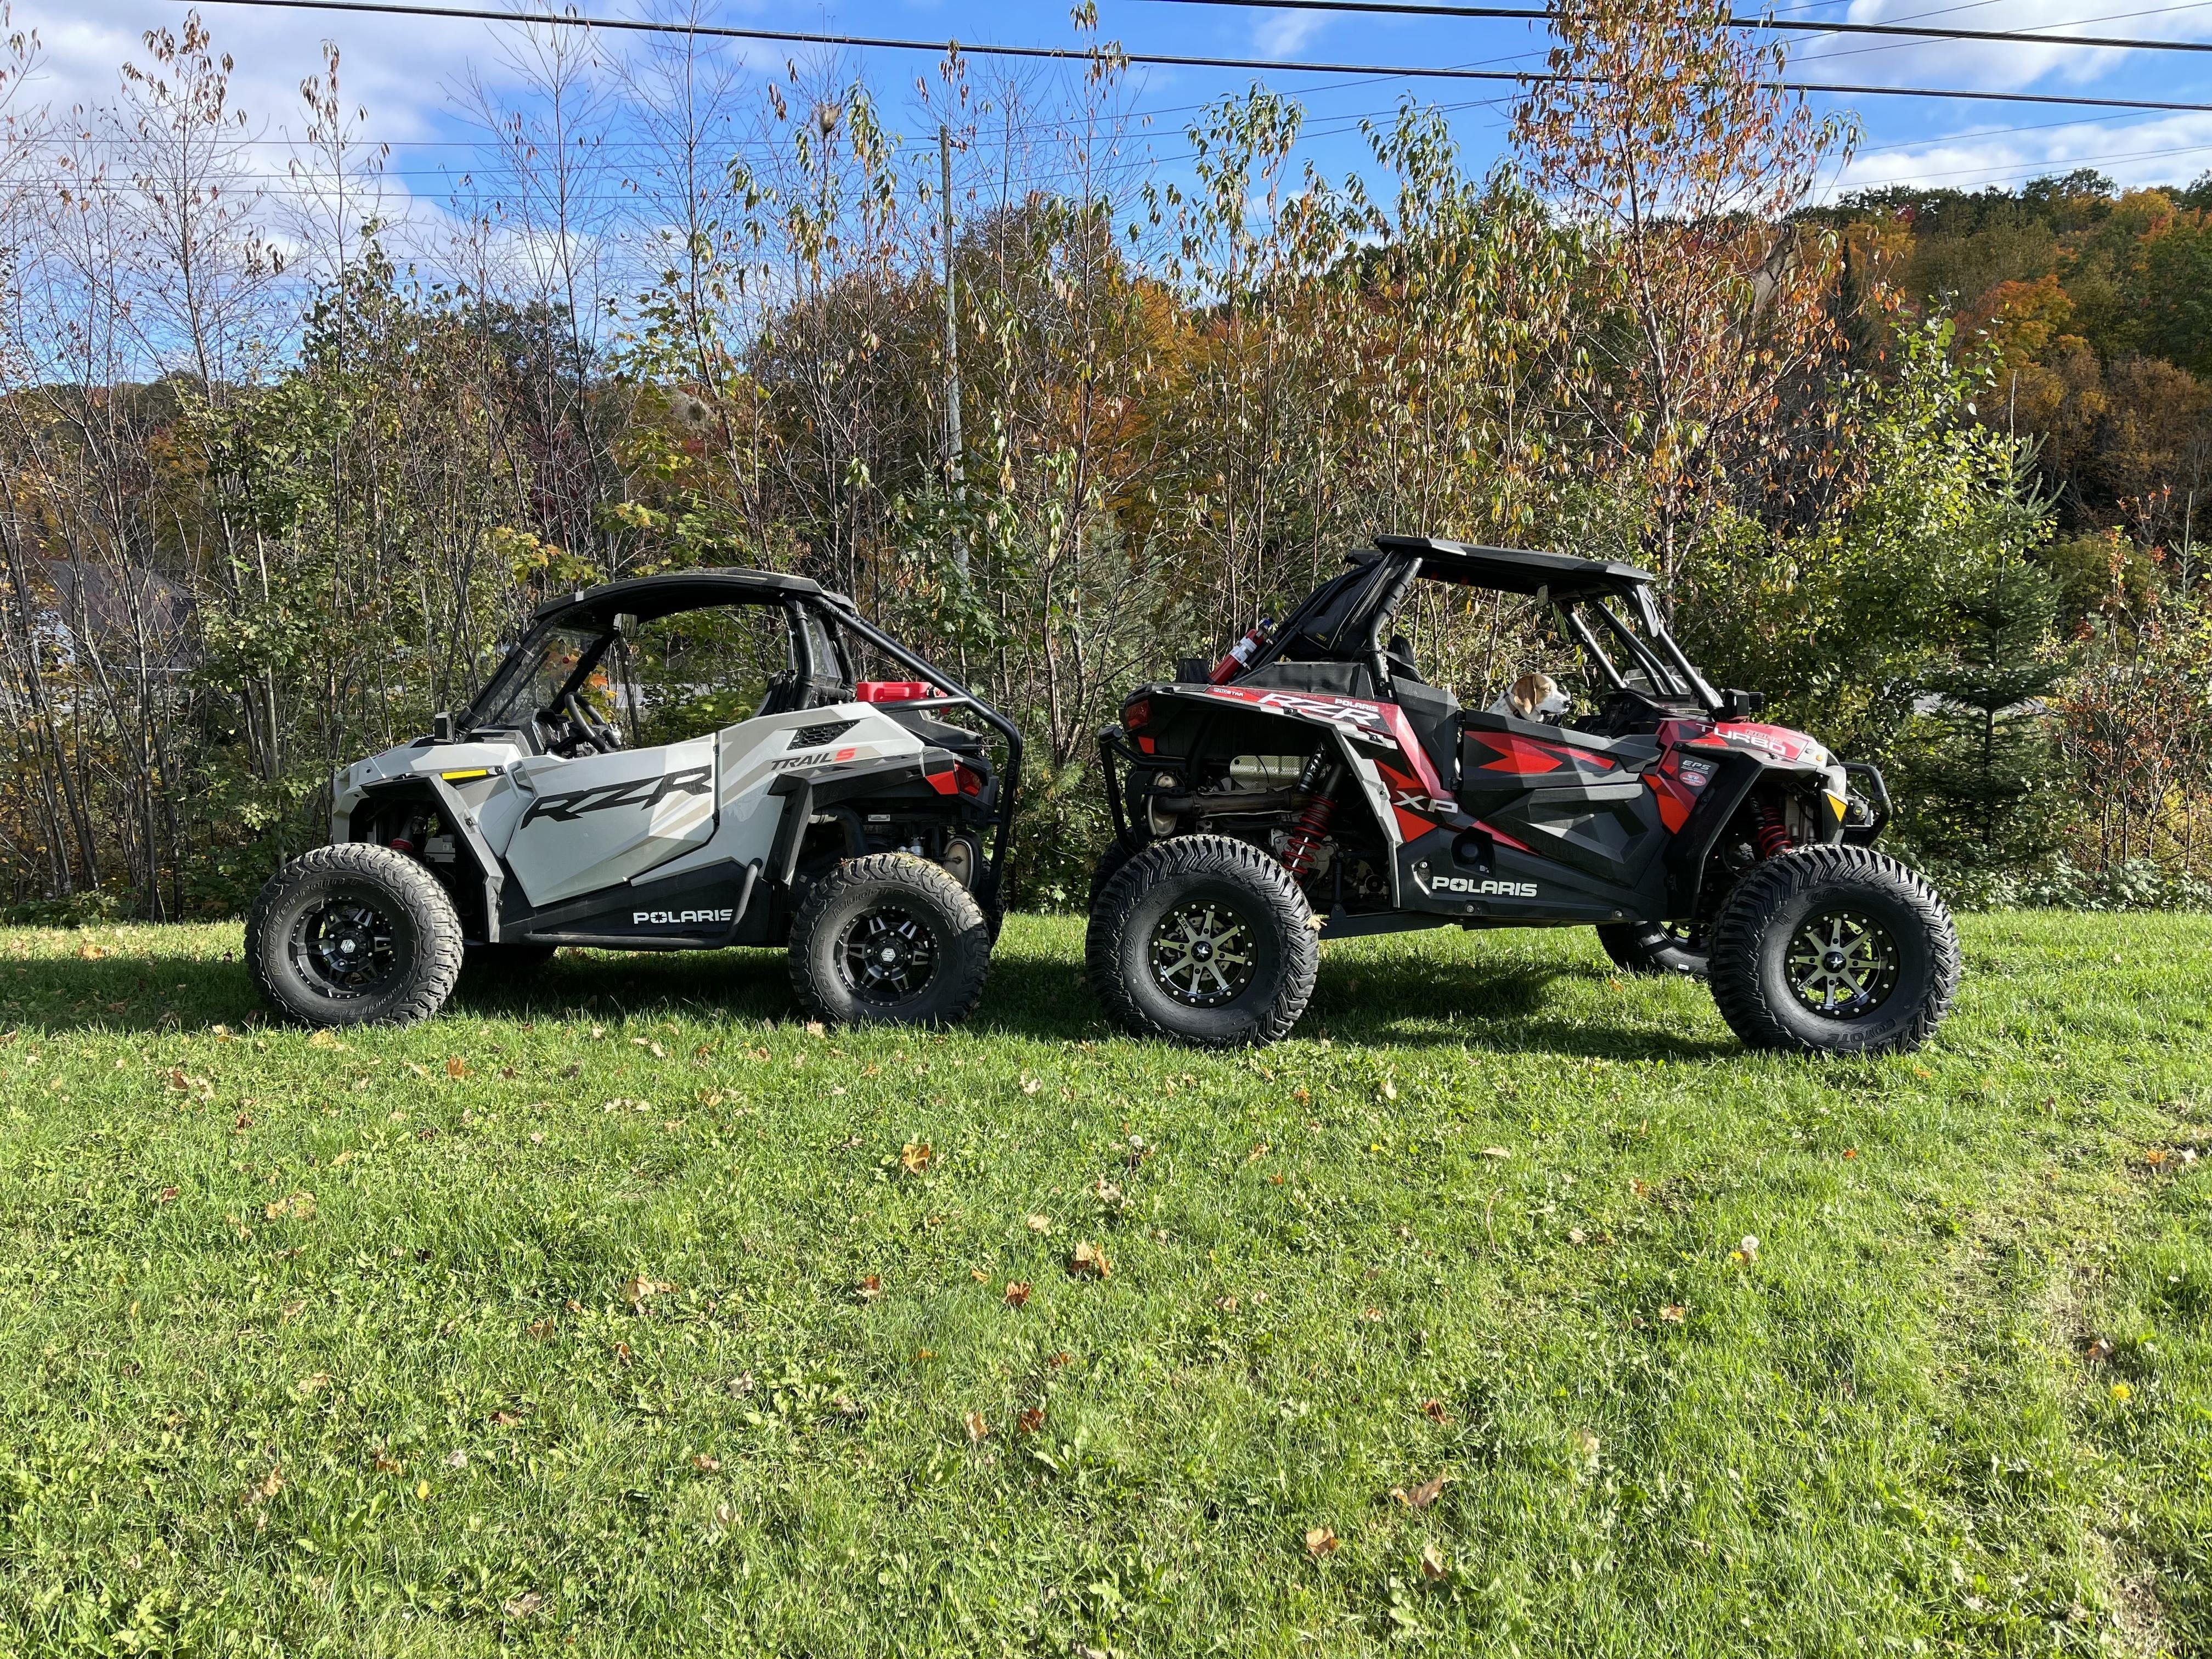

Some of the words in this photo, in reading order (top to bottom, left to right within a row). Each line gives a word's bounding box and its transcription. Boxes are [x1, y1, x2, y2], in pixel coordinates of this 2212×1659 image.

[1257, 693, 1380, 726] RZR
[1335, 698, 1379, 713] POLARIS
[1695, 723, 1786, 755] TURBO
[771, 752, 832, 771] TRAIL
[834, 747, 857, 762] S
[1682, 760, 1712, 770] EPS
[520, 764, 712, 830] RZR
[1393, 790, 1458, 813] XP
[1431, 876, 1537, 897] POLARIS
[633, 909, 733, 924] POLARIS
